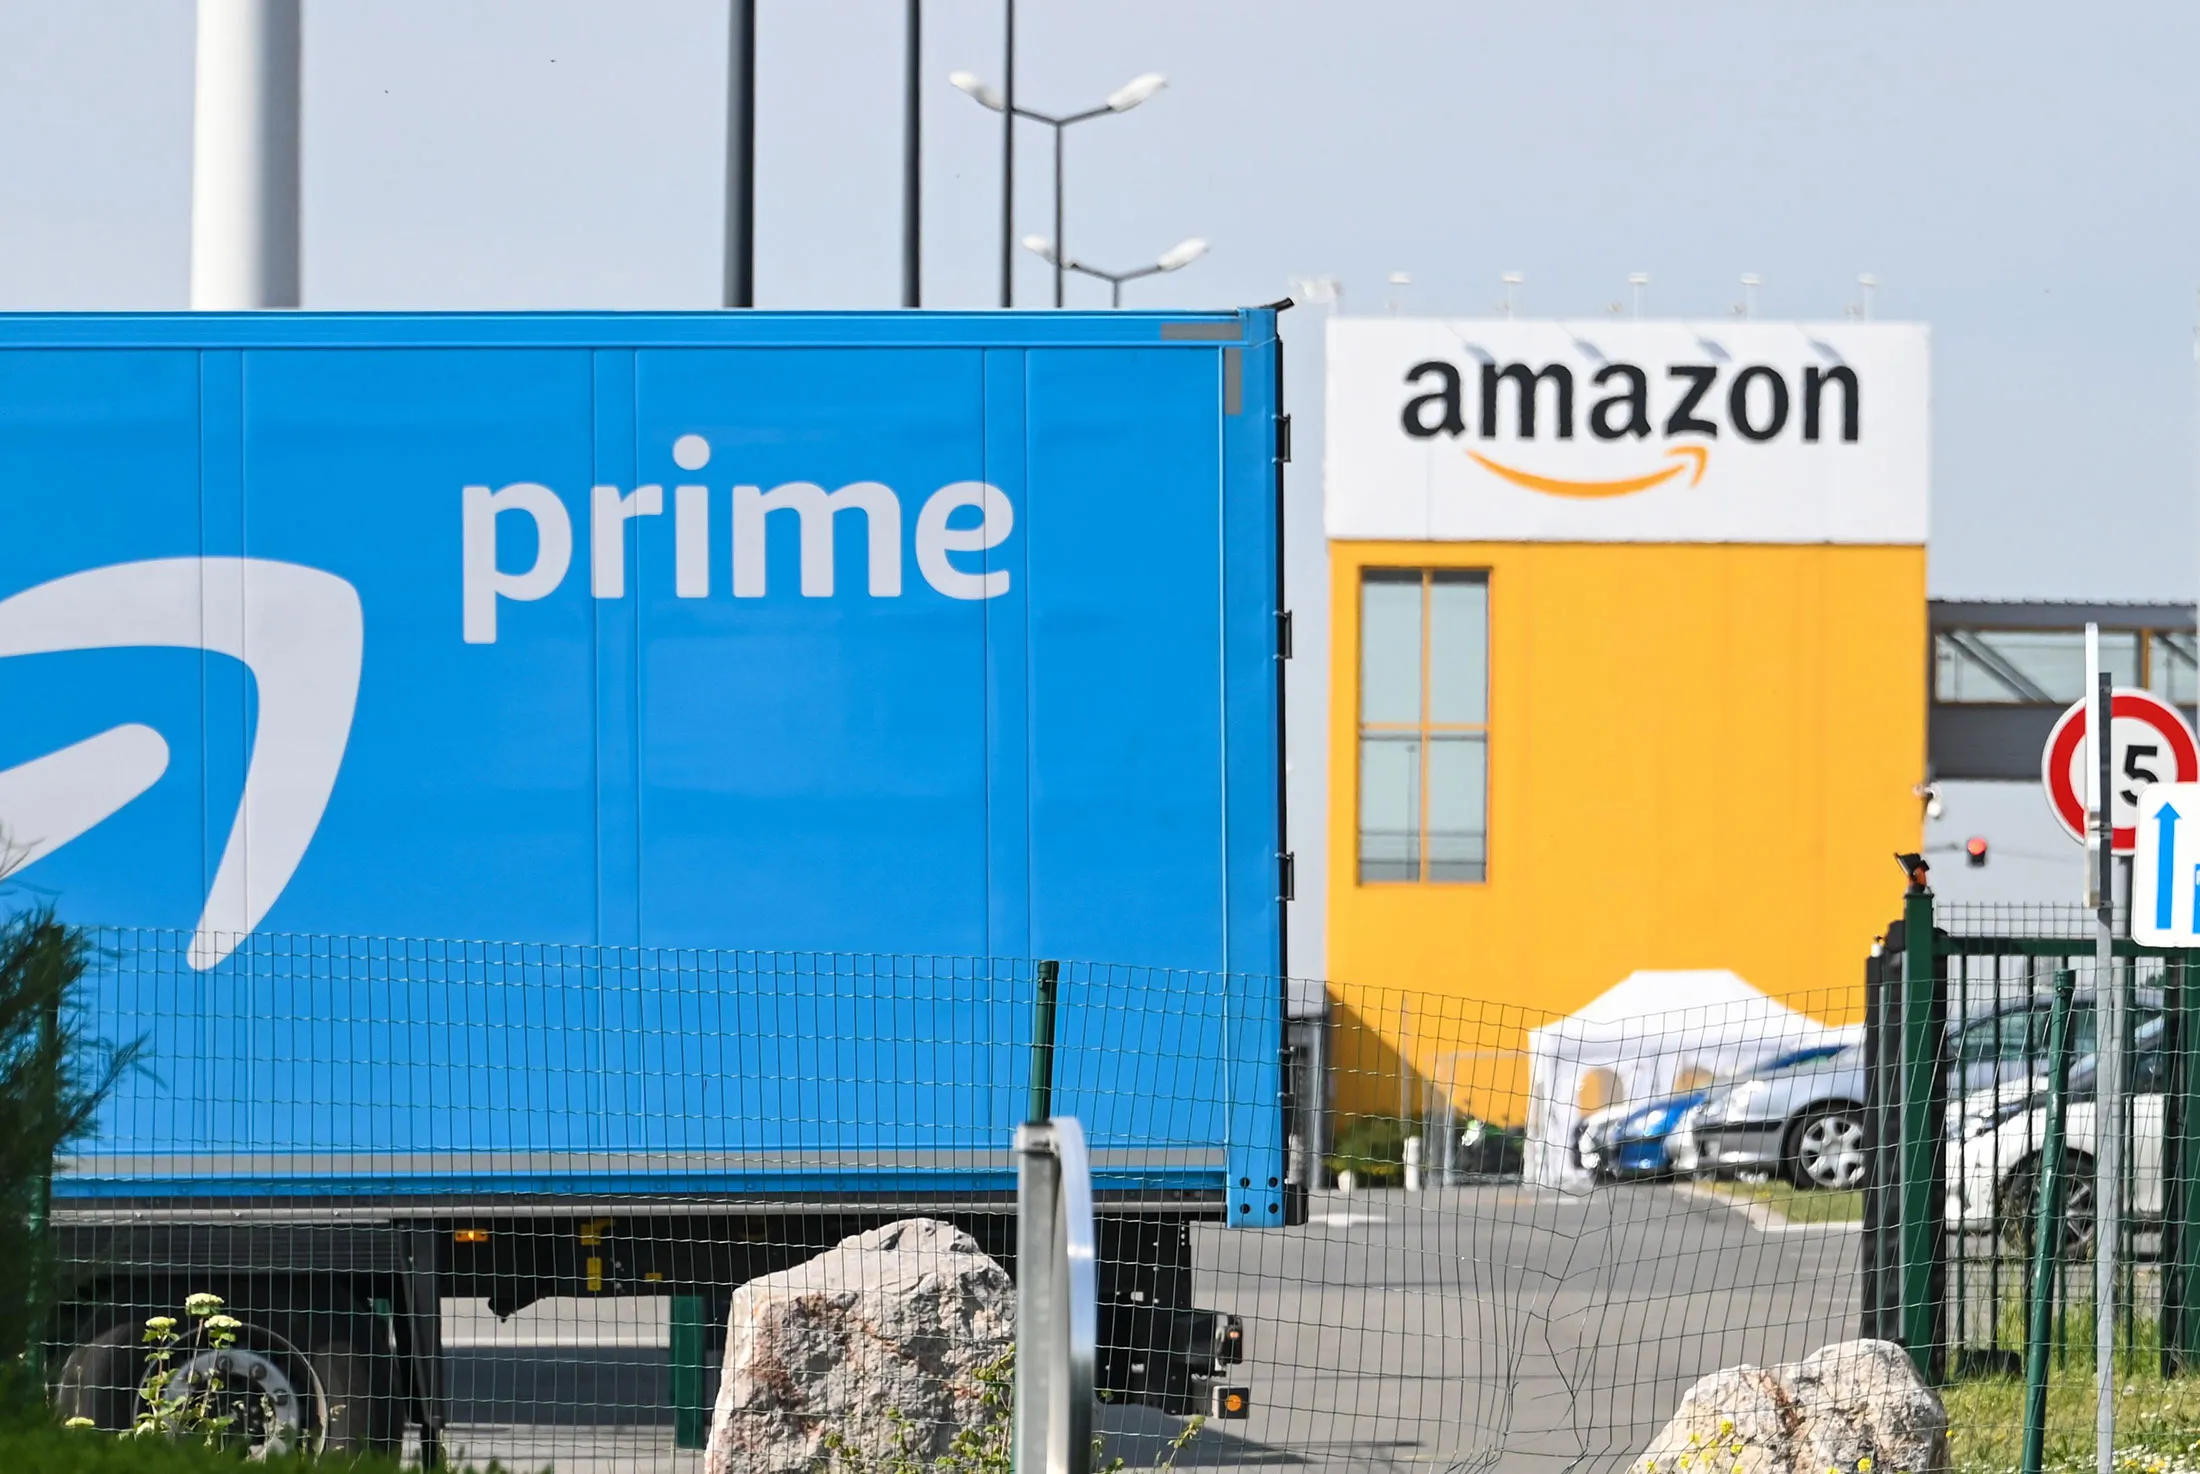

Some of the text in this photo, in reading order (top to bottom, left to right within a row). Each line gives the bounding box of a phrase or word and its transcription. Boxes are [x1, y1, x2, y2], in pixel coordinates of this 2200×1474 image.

[1401, 361, 1859, 443] amazon
[463, 434, 1014, 643] prime
[2121, 745, 2158, 806] 5
